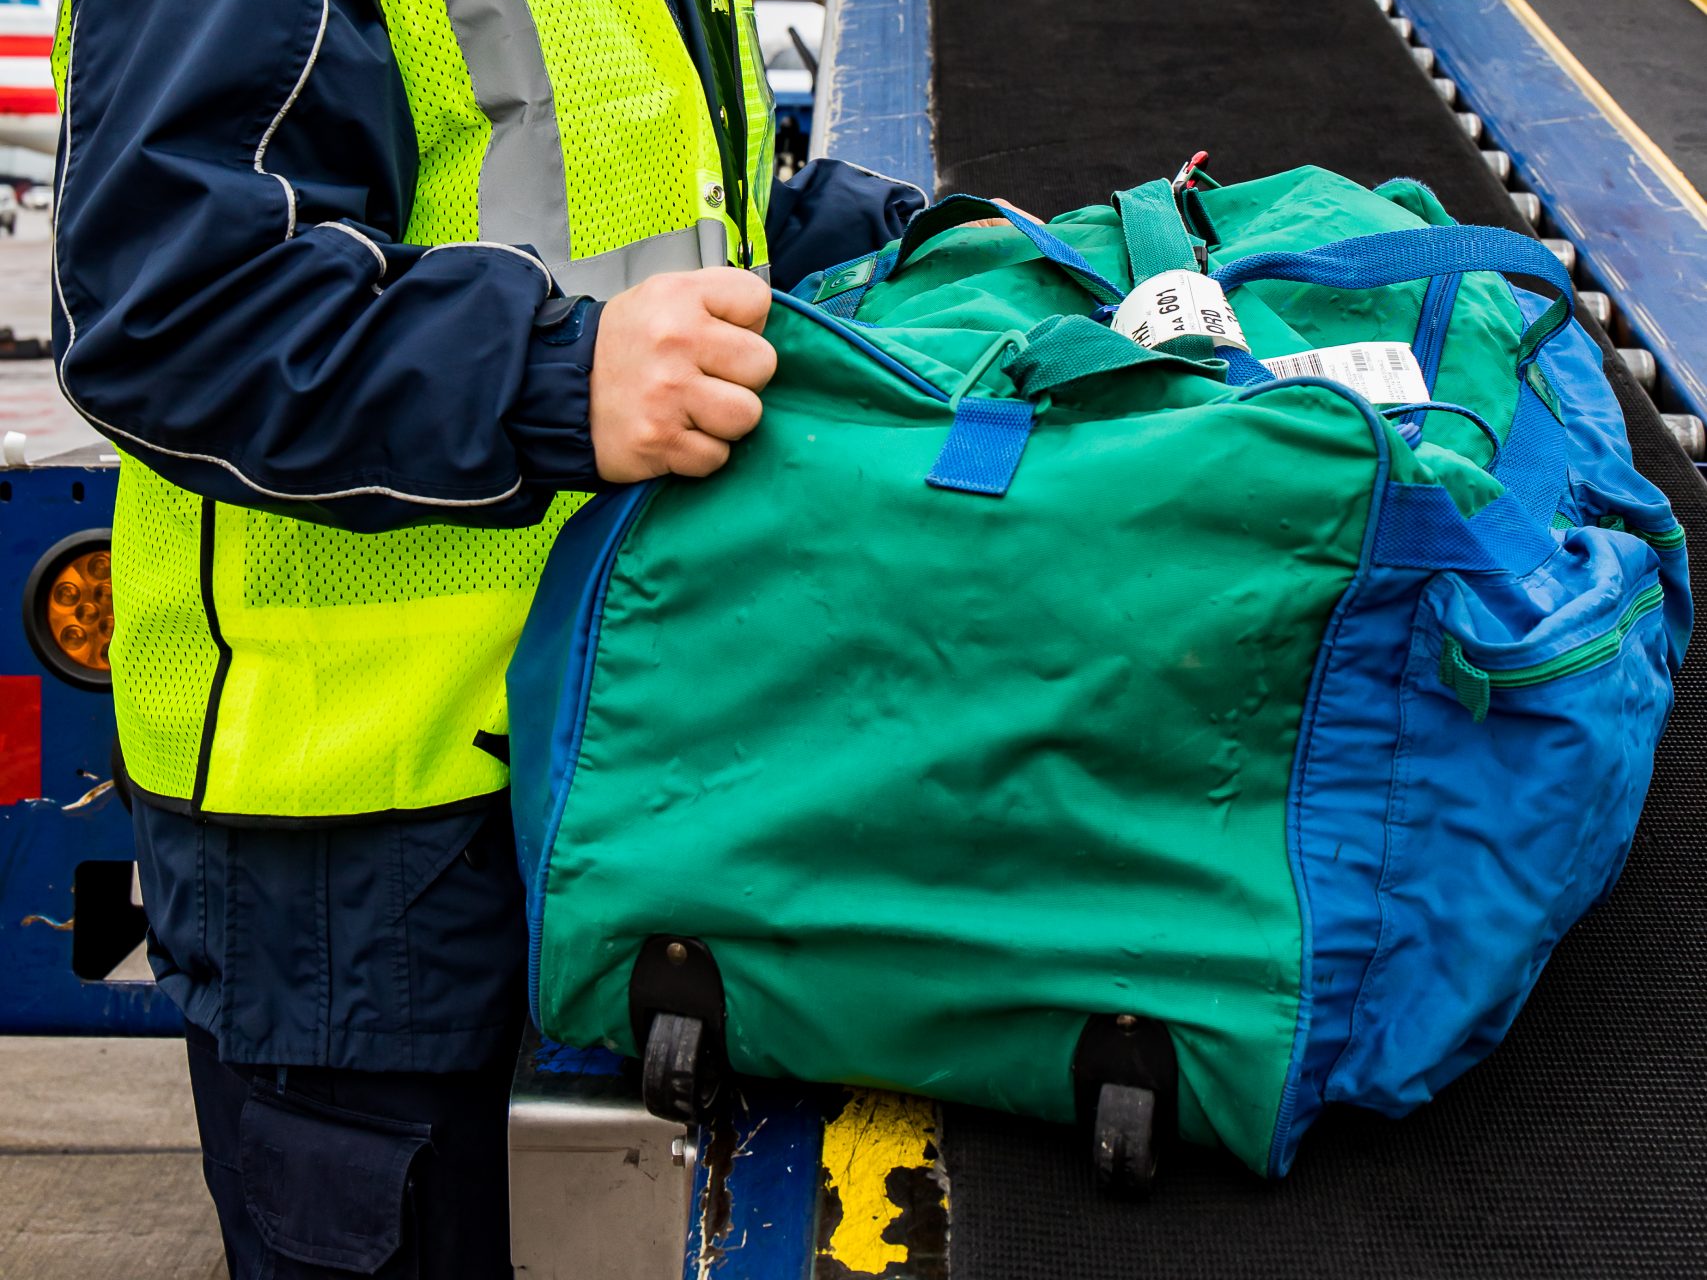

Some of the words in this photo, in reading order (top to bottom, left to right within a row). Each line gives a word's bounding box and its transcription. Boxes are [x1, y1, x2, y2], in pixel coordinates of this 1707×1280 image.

[1155, 288, 1180, 315] 601
[1172, 317, 1185, 331] AA
[1201, 309, 1226, 335] ORD
